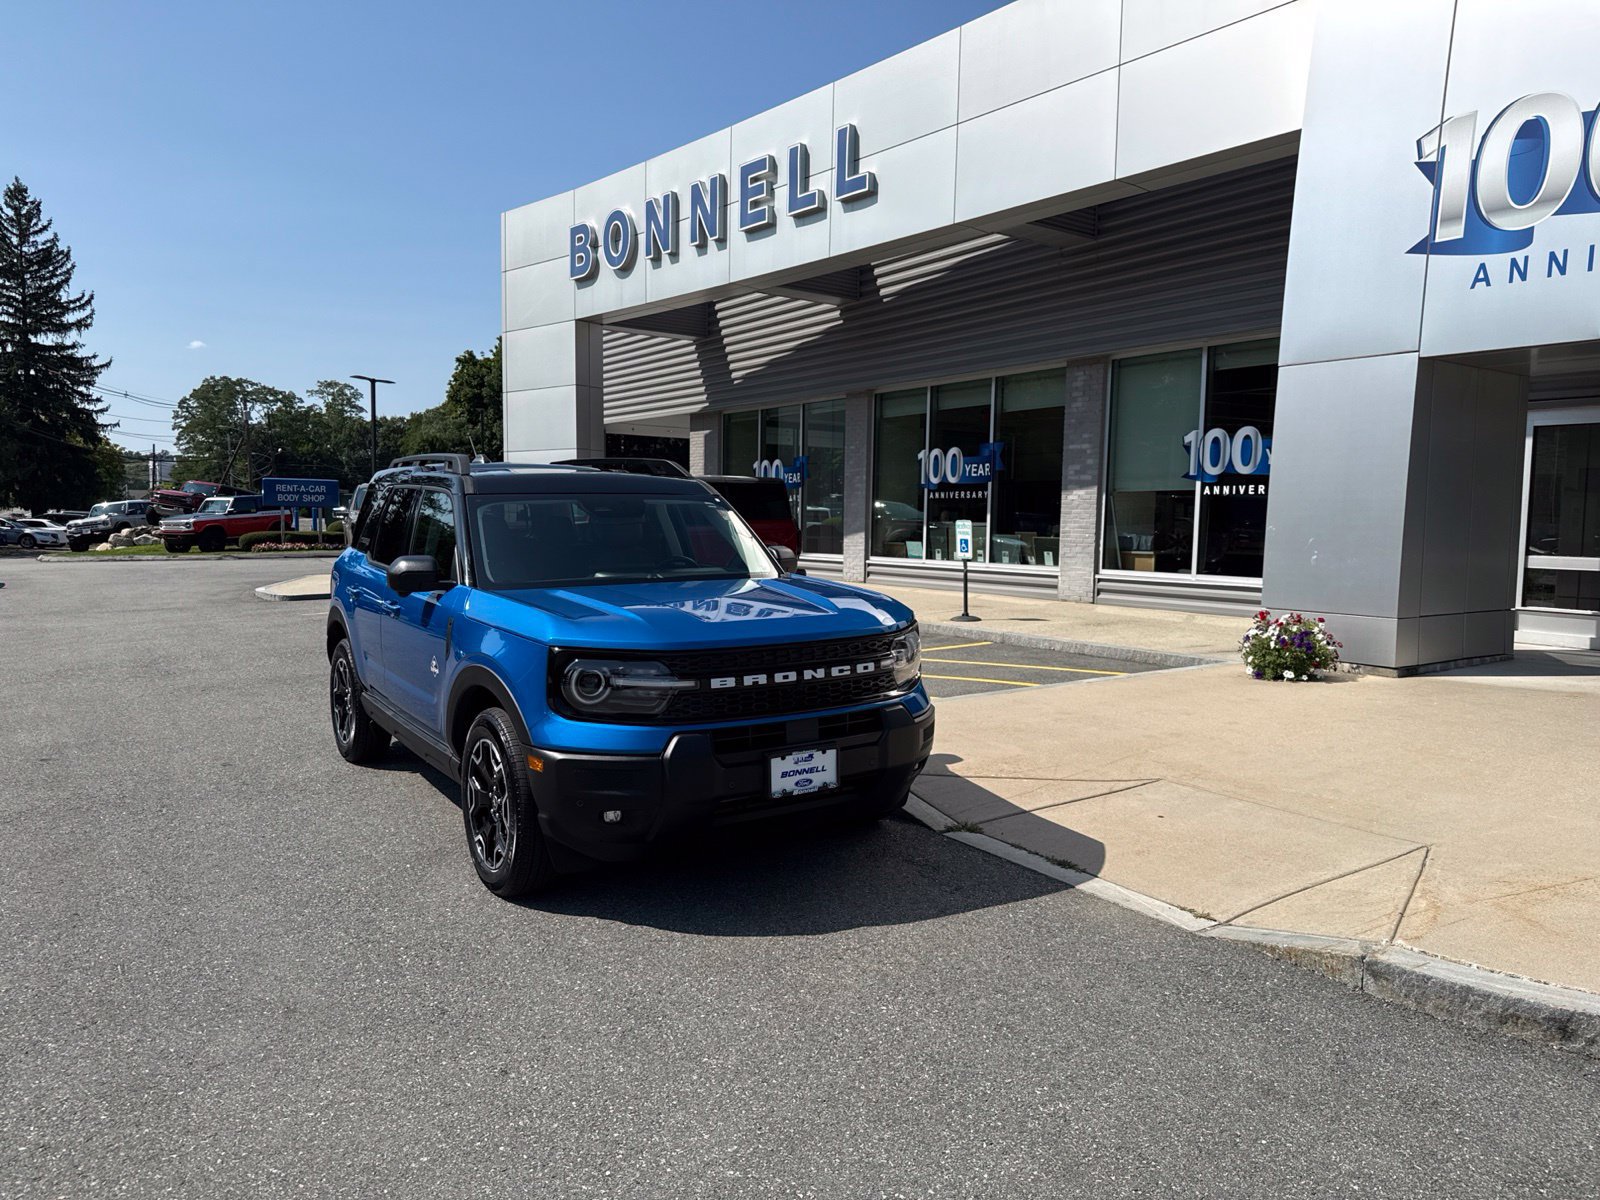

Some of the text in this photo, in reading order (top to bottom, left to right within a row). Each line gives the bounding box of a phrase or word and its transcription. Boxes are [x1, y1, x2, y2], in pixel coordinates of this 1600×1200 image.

[1416, 90, 1600, 243] 10
[569, 122, 874, 280] BONNELL
[1469, 244, 1596, 290] ANNI
[1183, 425, 1263, 476] 100
[917, 446, 991, 485] 100 YEAR
[275, 484, 327, 493] RENT-A-CAR
[277, 493, 326, 502] BODY SHOP
[929, 490, 989, 499] ANNIVERSARY
[1203, 484, 1266, 495] ANNIVER
[710, 662, 875, 689] BRONCO
[780, 765, 828, 779] BONNELL
